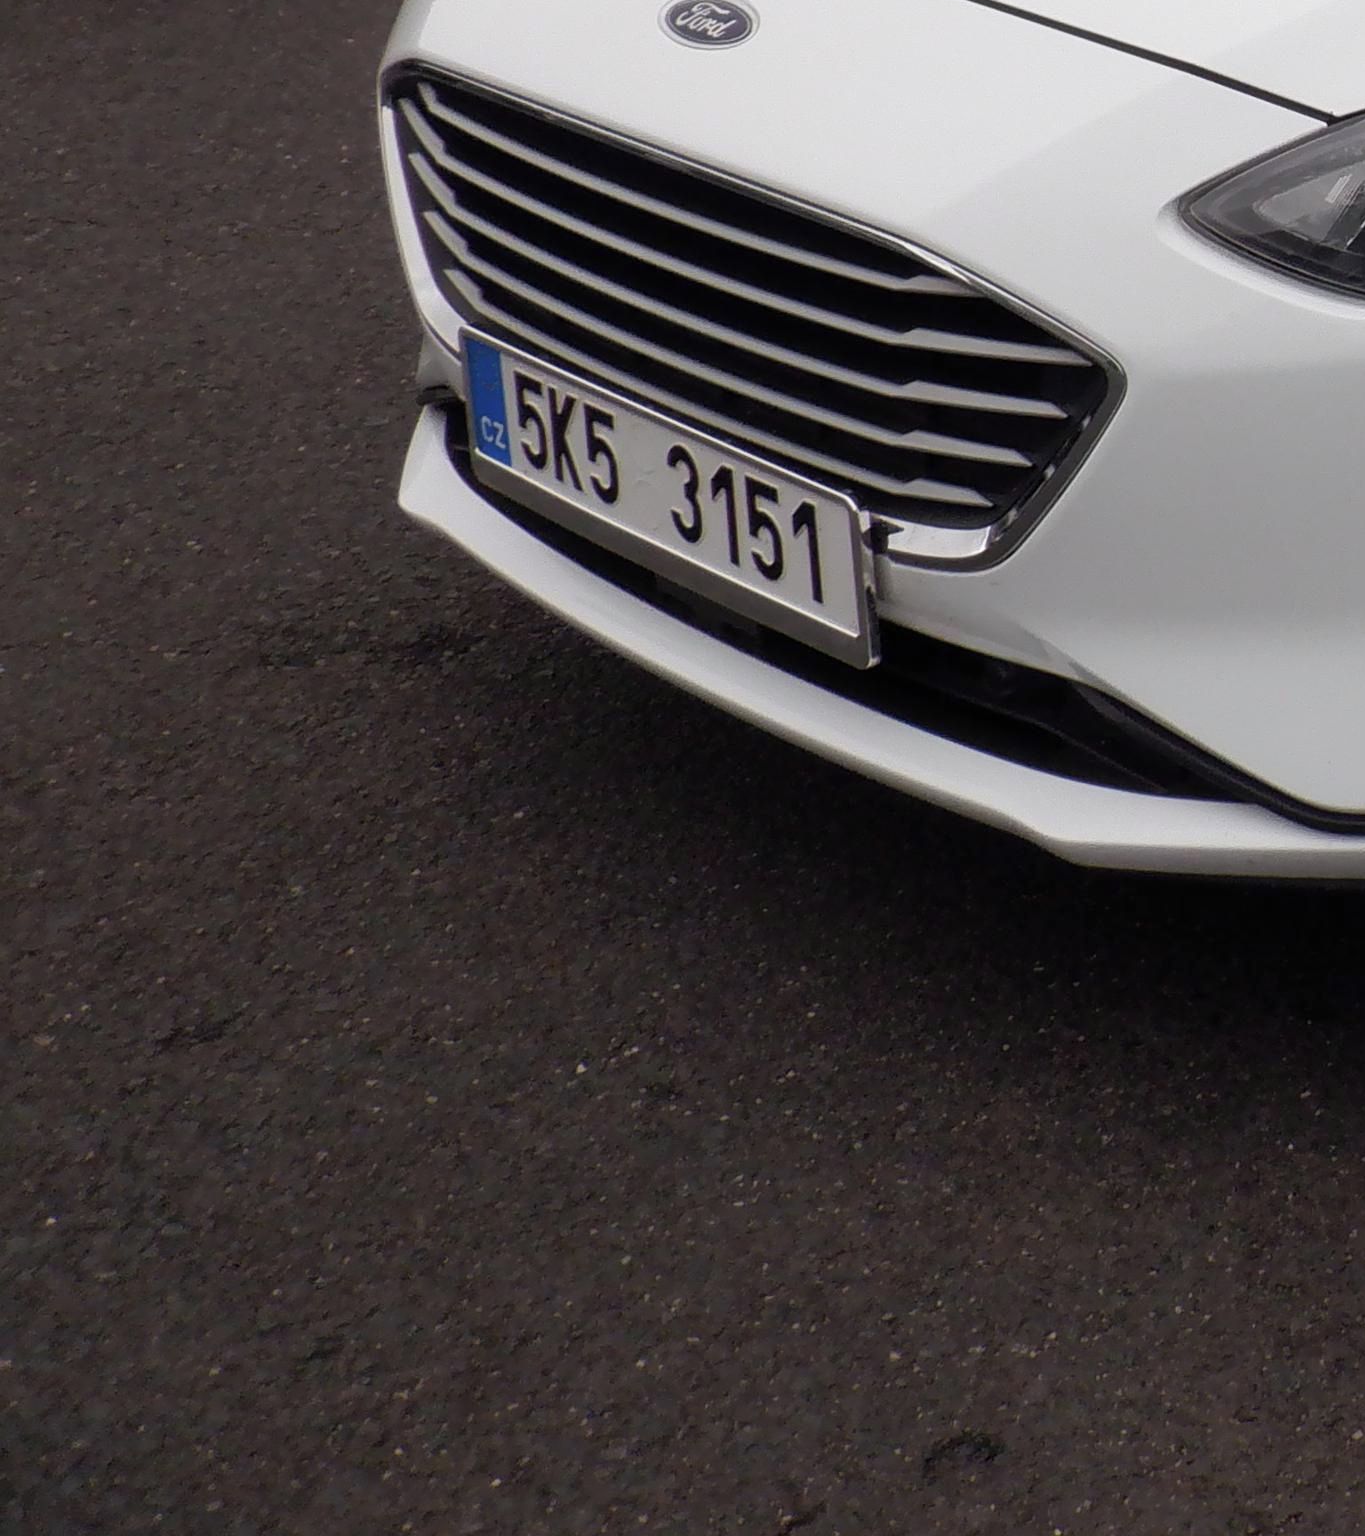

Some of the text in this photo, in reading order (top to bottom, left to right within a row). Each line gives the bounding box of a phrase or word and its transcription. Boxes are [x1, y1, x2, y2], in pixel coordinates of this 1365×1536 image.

[676, 2, 737, 38] Ford
[480, 415, 507, 450] CZ
[514, 368, 825, 605] 5K5 3151
